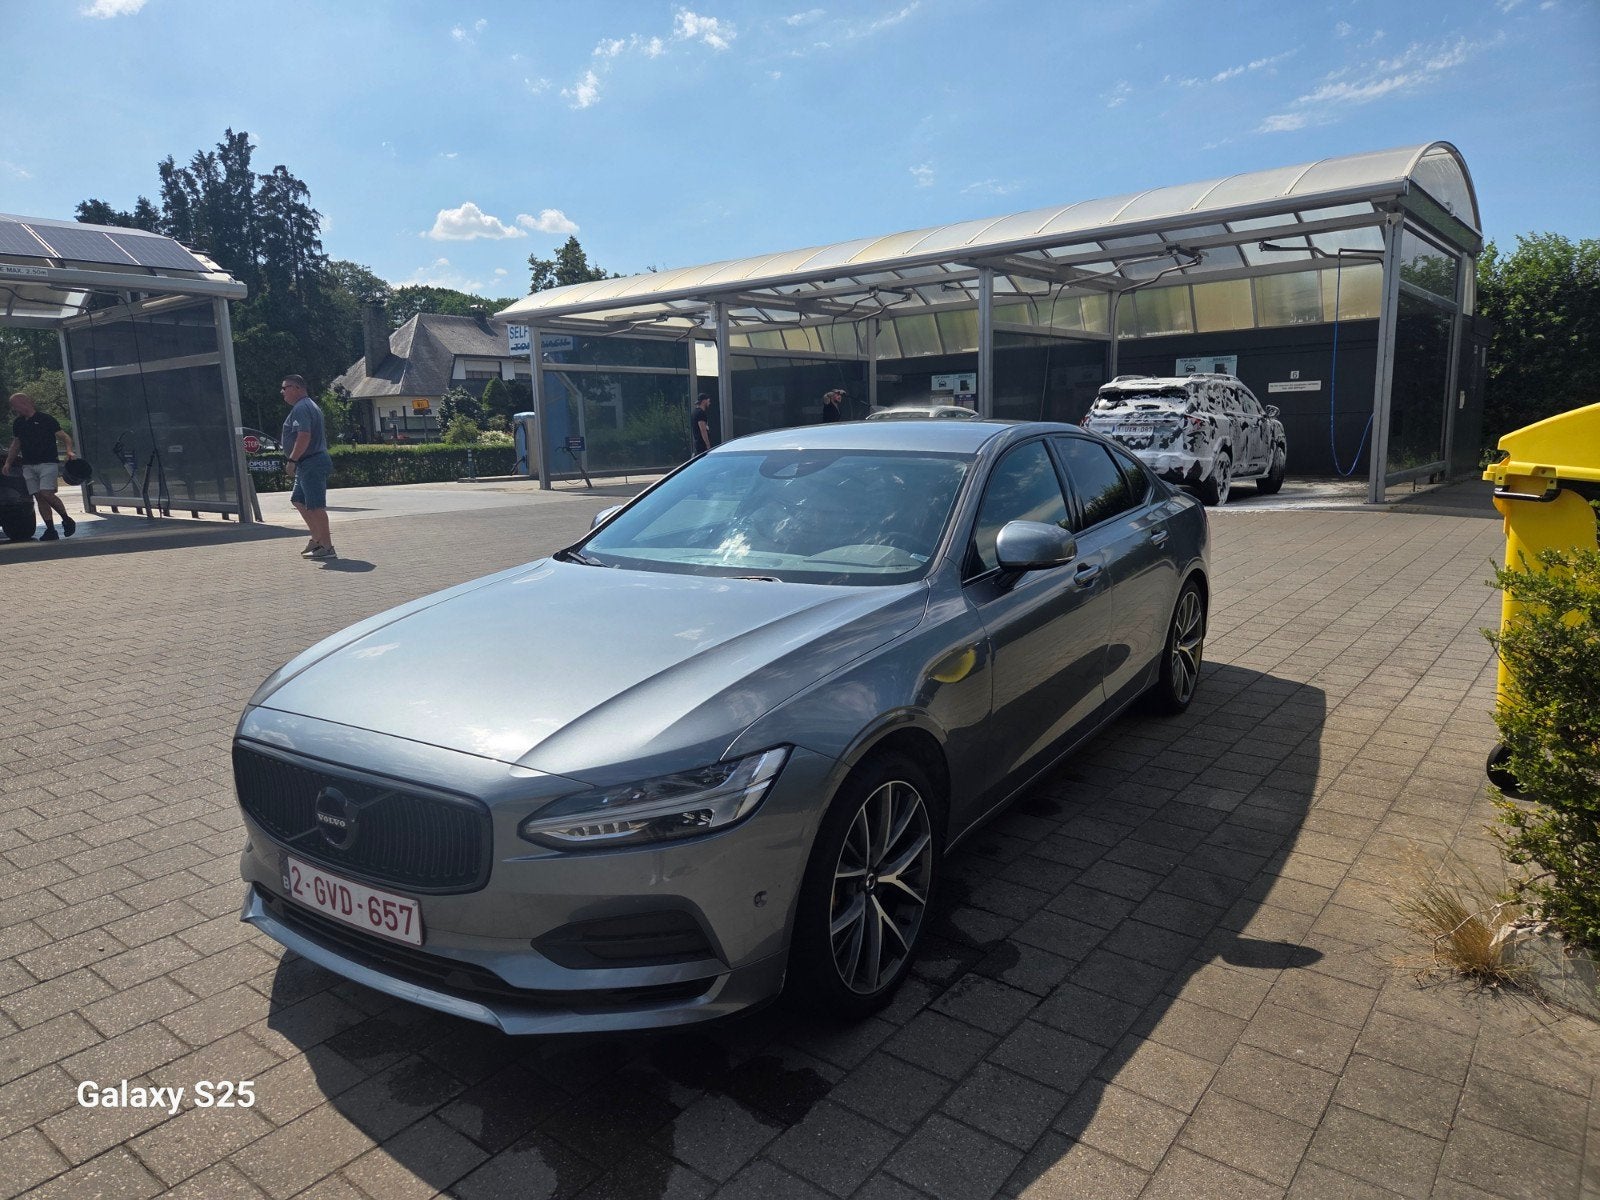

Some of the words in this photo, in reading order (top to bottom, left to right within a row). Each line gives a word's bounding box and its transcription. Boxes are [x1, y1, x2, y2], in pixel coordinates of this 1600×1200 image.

[509, 326, 528, 340] SELF
[243, 440, 259, 448] STOP
[318, 813, 346, 828] VOLVO
[291, 866, 413, 936] 2-GVD-657
